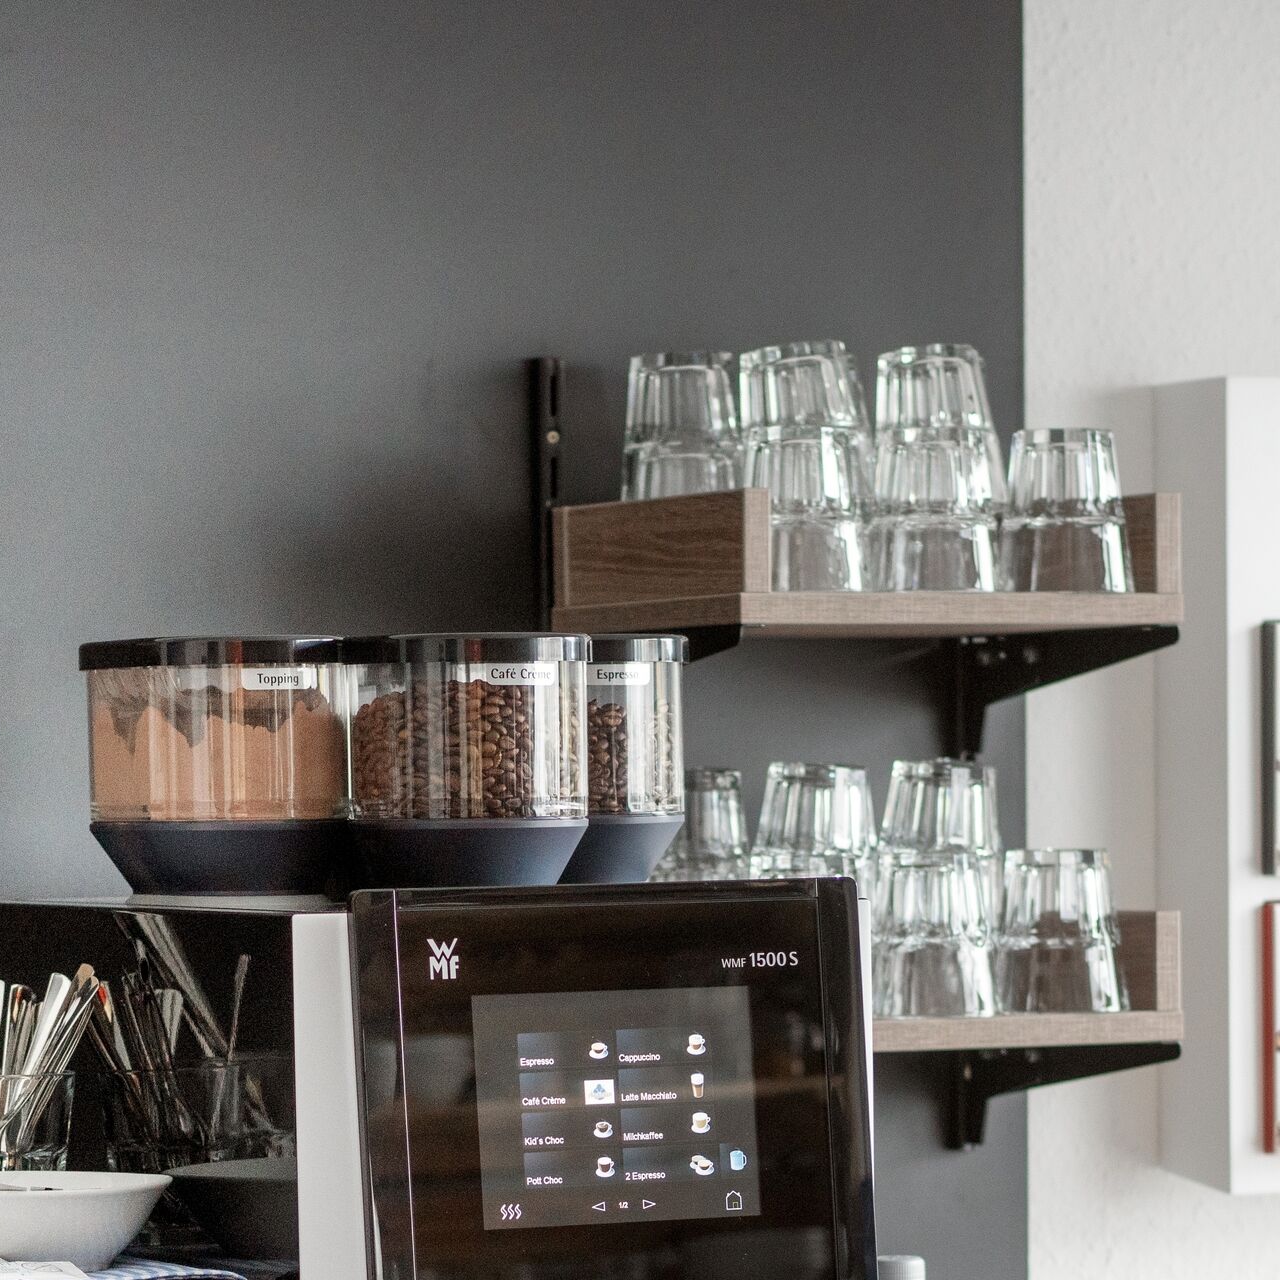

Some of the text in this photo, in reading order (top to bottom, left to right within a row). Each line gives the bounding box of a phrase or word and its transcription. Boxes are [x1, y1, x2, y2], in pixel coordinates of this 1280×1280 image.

[491, 668, 517, 679] Café
[597, 669, 640, 681] Espresso
[257, 673, 299, 686] Topping
[426, 938, 460, 981] WMF
[721, 951, 799, 968] WMF 1500 S
[520, 1057, 555, 1067] Espresso
[619, 1052, 661, 1063] Cappuccino
[522, 1096, 566, 1106] Café Crème
[621, 1091, 677, 1102] Latte Macchiato
[545, 1136, 564, 1145] Choc
[623, 1132, 664, 1141] Milchkaffee
[526, 1176, 563, 1185] Pott Choc
[625, 1171, 666, 1181] 2 Espresso
